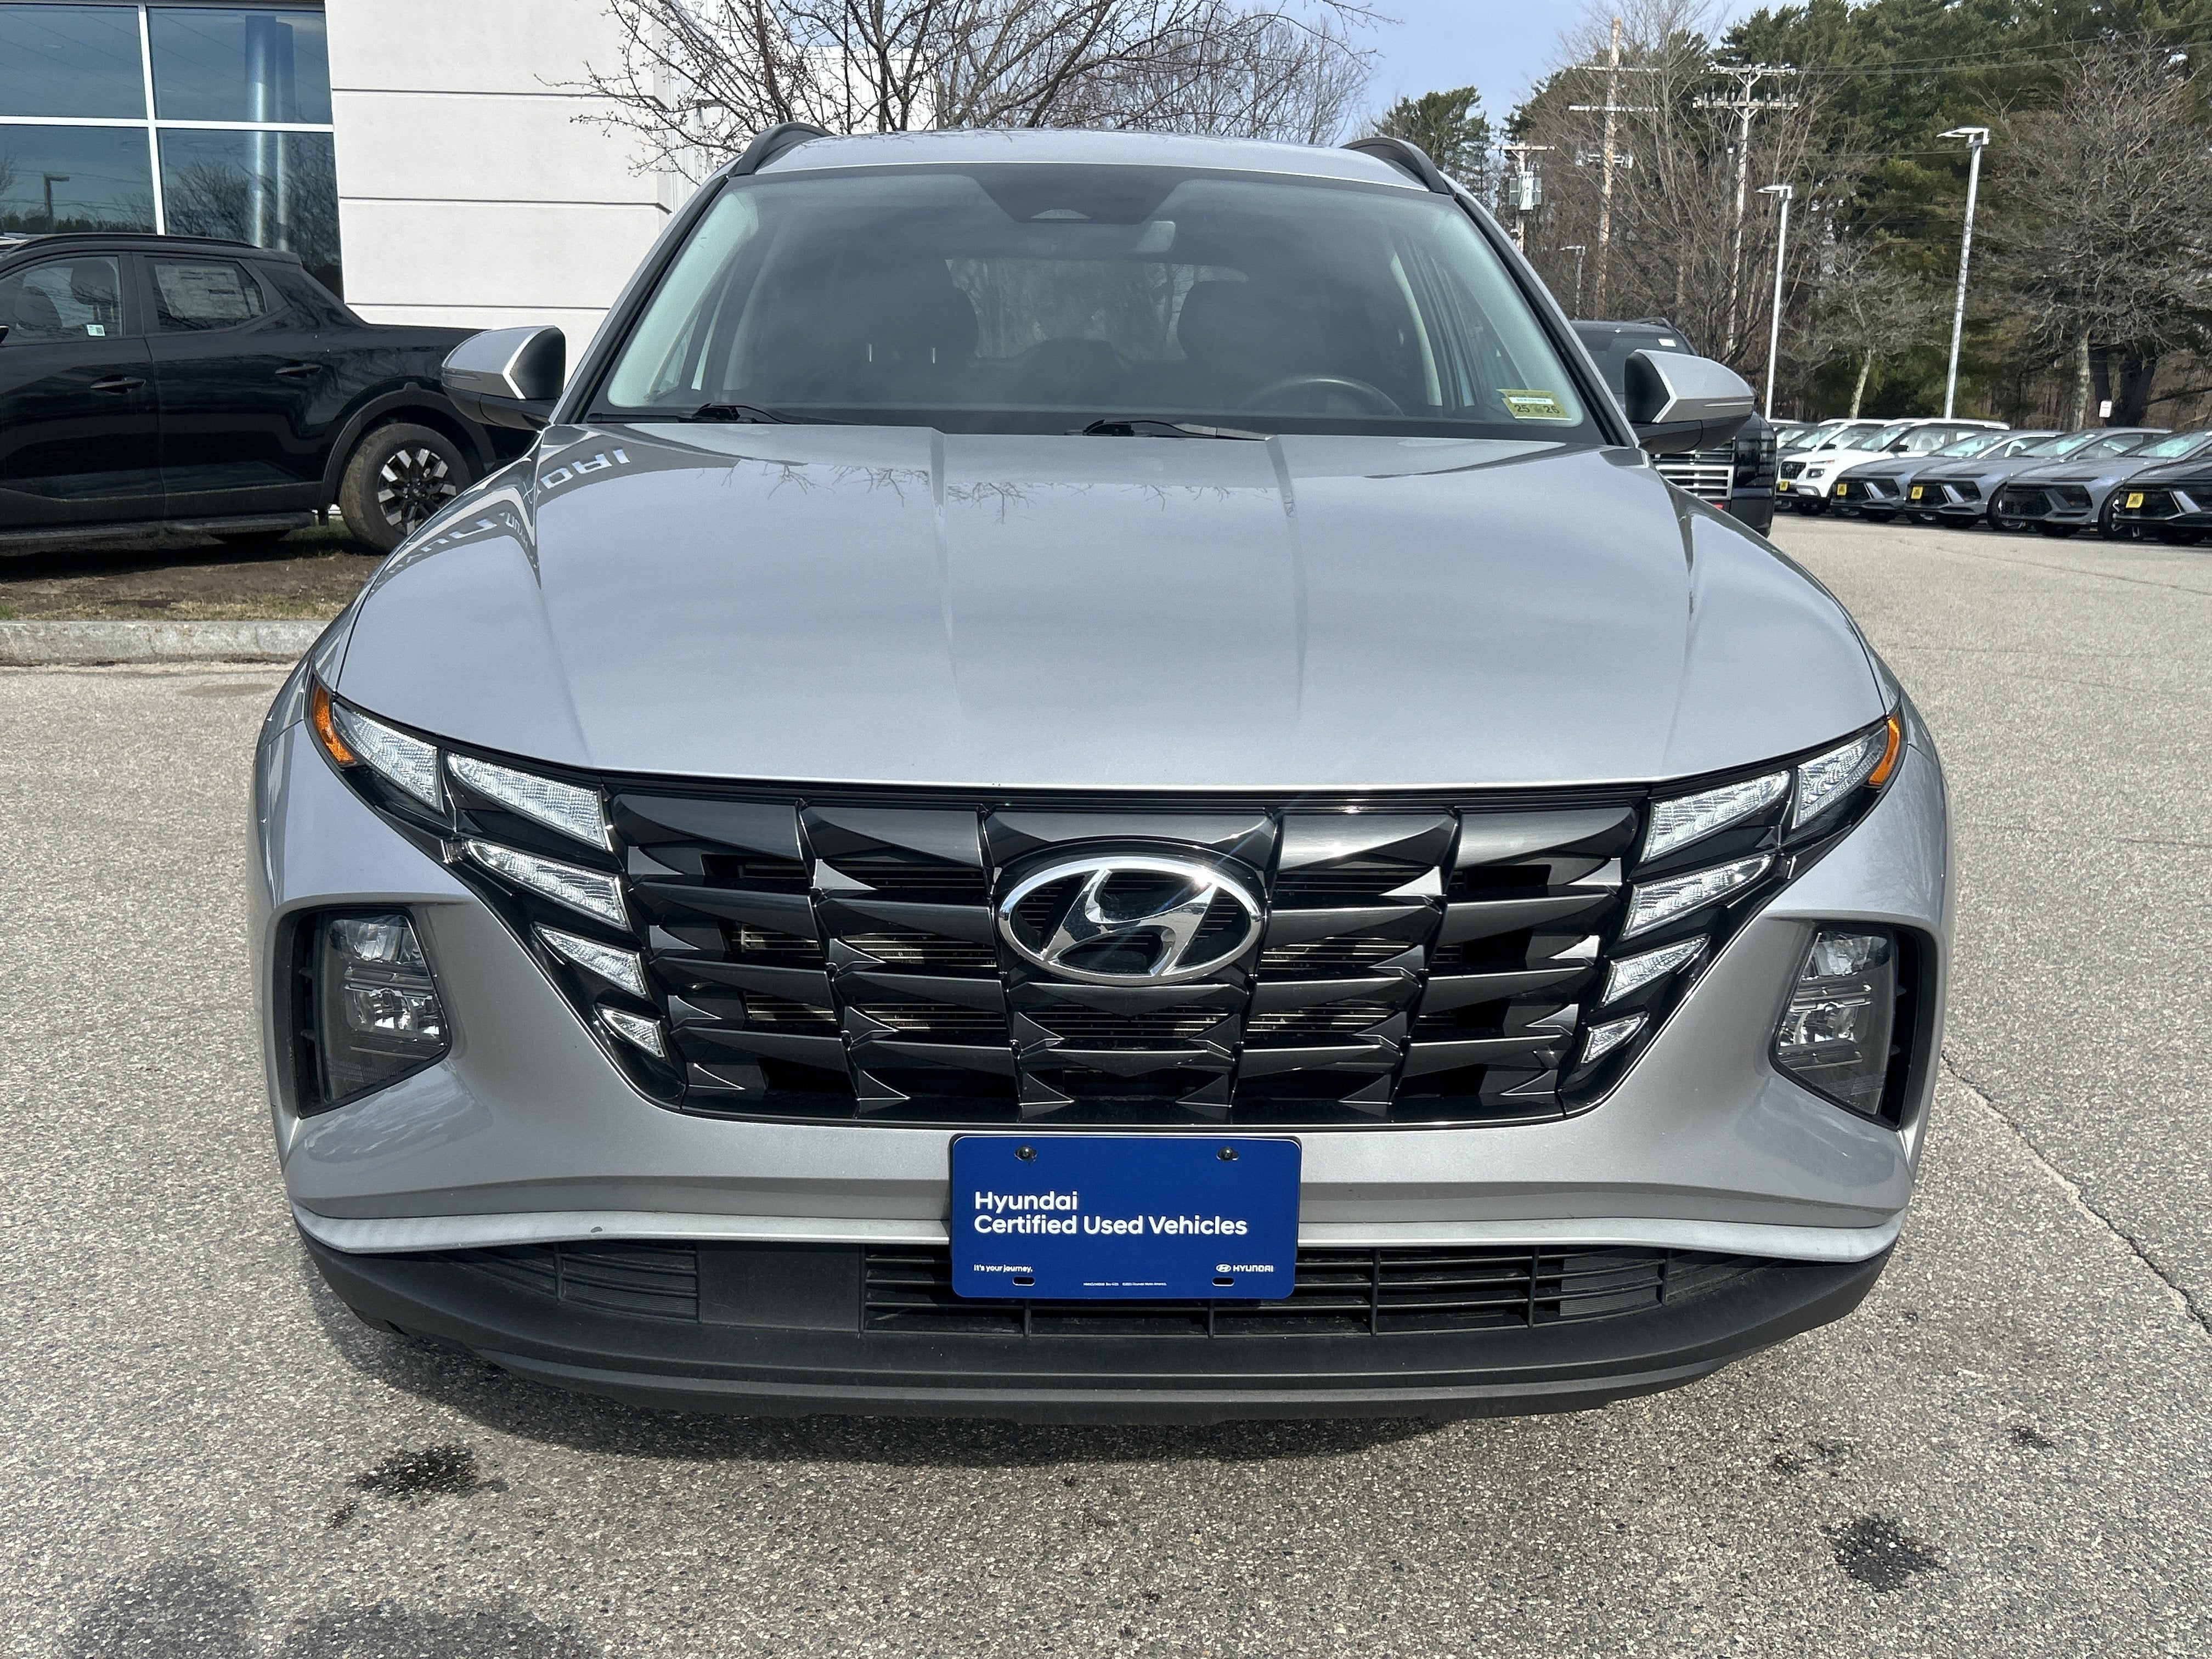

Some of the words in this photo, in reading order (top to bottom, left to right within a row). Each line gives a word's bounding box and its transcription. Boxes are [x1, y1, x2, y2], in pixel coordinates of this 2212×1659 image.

[1514, 404, 1531, 413] 25
[1543, 405, 1560, 414] 26
[974, 1190, 1078, 1214] Hyundai
[974, 1214, 1077, 1234] Certified
[1084, 1215, 1143, 1235] Used
[1148, 1215, 1248, 1235] Vehicles
[1003, 1264, 1034, 1273] journey.
